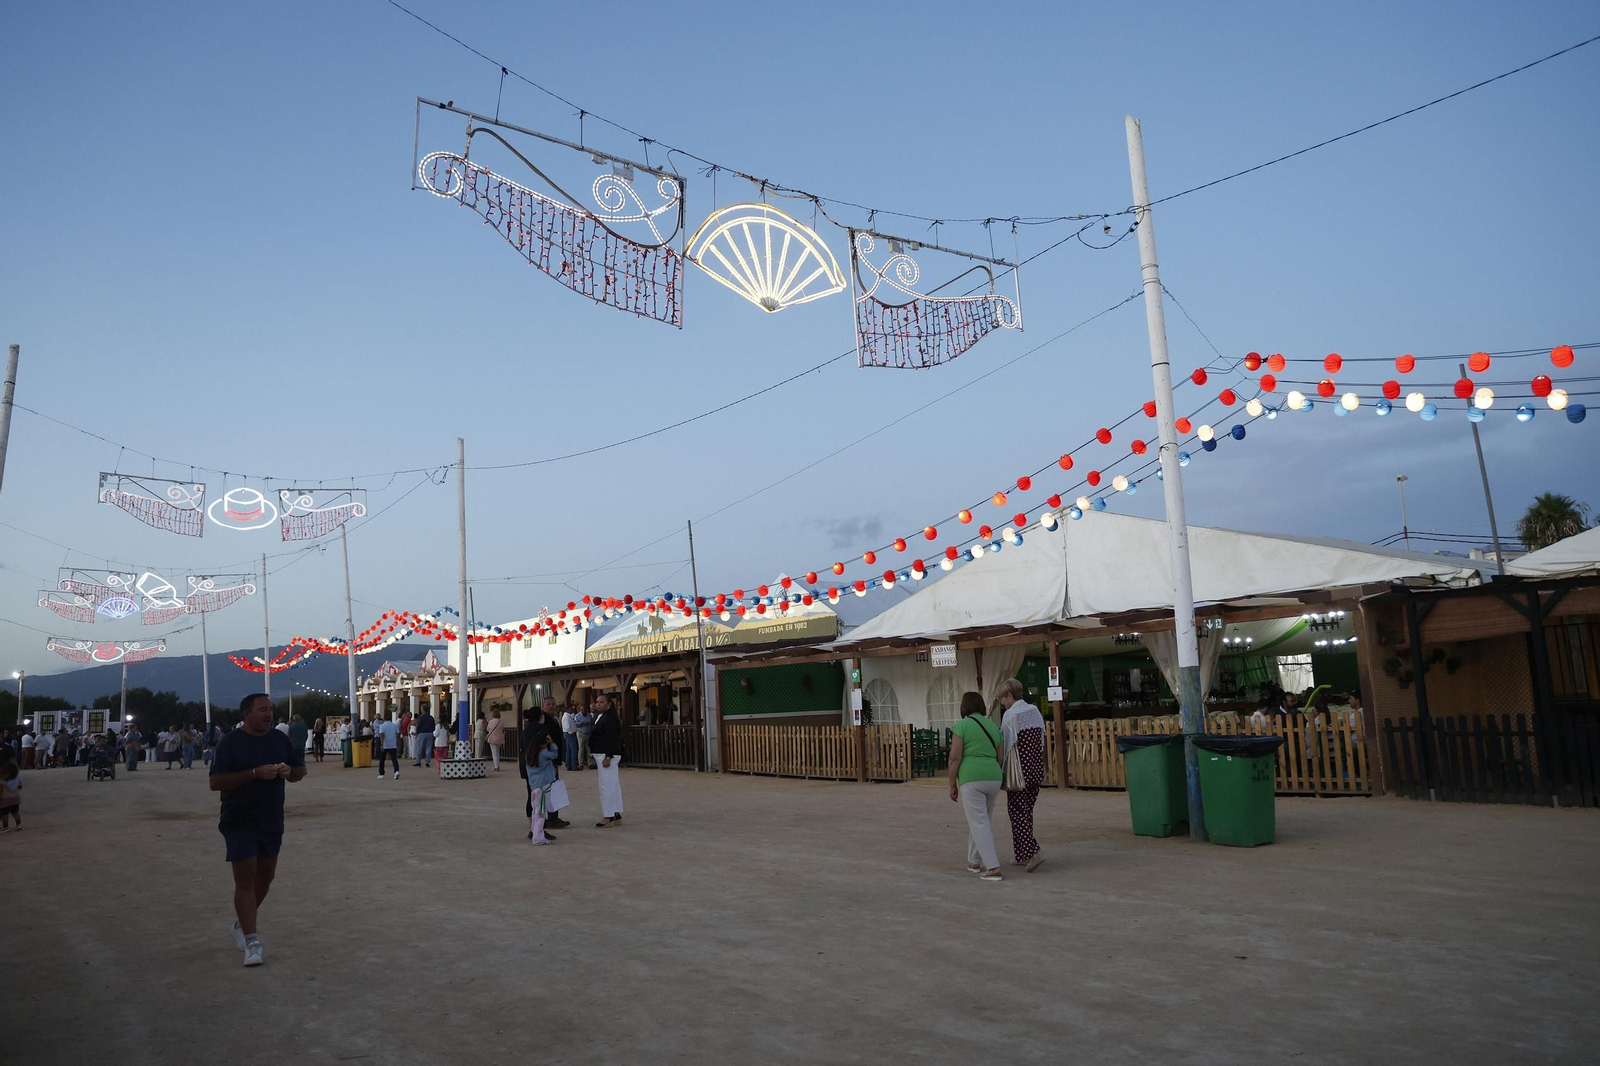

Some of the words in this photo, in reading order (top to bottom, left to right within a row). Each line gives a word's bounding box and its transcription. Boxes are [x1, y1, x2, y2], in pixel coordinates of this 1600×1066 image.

[758, 625, 784, 635] FUNDADA
[785, 623, 793, 631] EN
[794, 621, 808, 632] 1982
[599, 648, 625, 662] CASETA
[626, 642, 657, 659] AMIGOS
[673, 635, 713, 652] CABALO
[931, 646, 956, 654] FANDANGO
